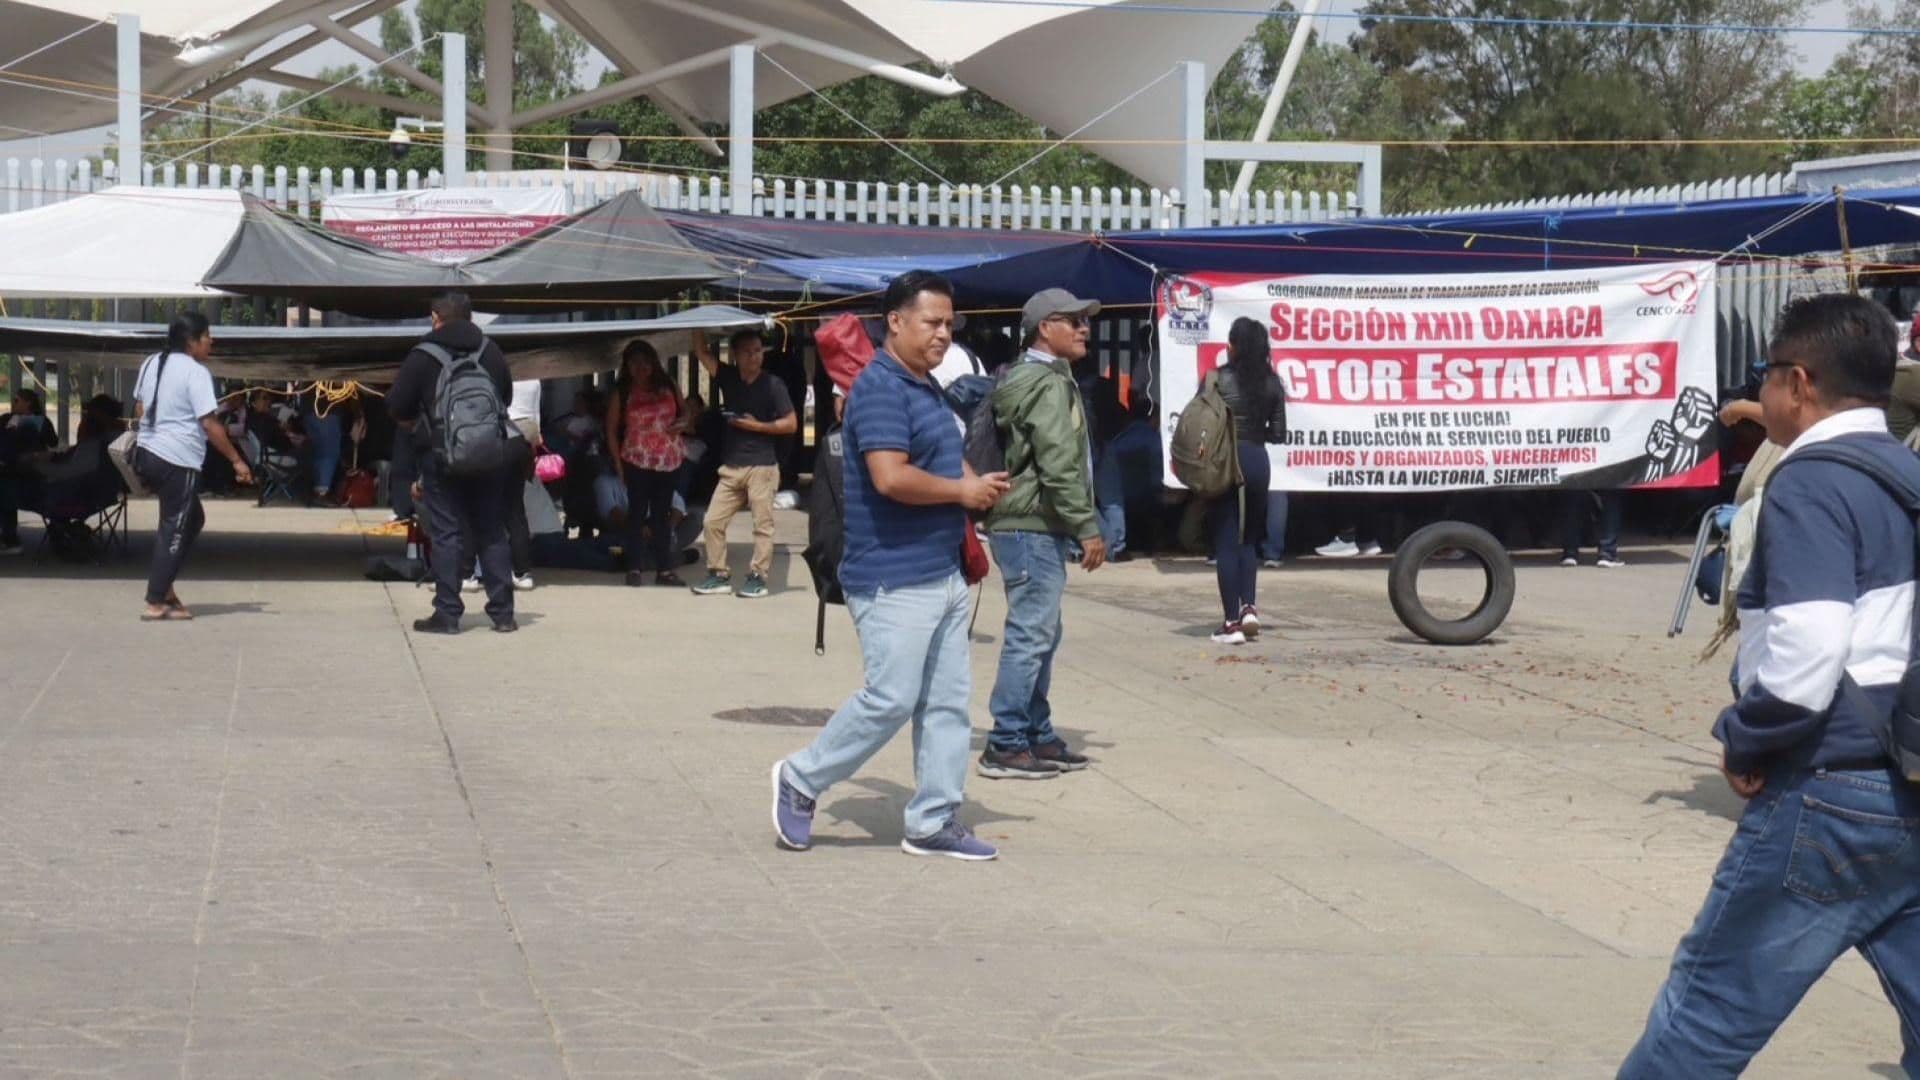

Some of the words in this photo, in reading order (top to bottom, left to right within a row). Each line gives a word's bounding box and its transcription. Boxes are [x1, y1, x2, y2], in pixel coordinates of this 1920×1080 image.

[410, 223, 420, 231] DE
[422, 222, 451, 230] ACCESO
[460, 221, 475, 229] LAS
[476, 220, 534, 229] INSTALACIONES
[1267, 283, 1353, 299] COORDINADORA
[1354, 285, 1408, 299] NACIONAL
[1410, 286, 1425, 298] DE
[1427, 284, 1507, 299] TRABAJADORES
[1508, 284, 1523, 297] DE
[1524, 283, 1538, 296] LA
[1538, 279, 1600, 296] EDUCACIÓN
[1270, 302, 1406, 342] SECCIÓN
[1412, 310, 1474, 341] XXII
[1479, 304, 1603, 341] OAXACA
[1215, 347, 1402, 401] CTOR
[1416, 352, 1662, 401] ESTATALES
[1374, 412, 1398, 429] ¡EN
[1402, 412, 1427, 428] PIE
[1430, 412, 1451, 427] DE
[1453, 411, 1511, 427] LUCHA!
[1285, 430, 1305, 446] OR
[1309, 430, 1328, 446] LA
[1331, 428, 1422, 446] EDUCACIÓN
[1426, 430, 1445, 446] AL
[1447, 429, 1522, 446] SERVICIO
[1525, 428, 1553, 445] DEL
[1556, 426, 1611, 444] PUEBLO
[1287, 450, 1355, 468] ¡UNIDOS
[1360, 450, 1369, 466] Y
[1373, 449, 1489, 467] ORGANIZADOS,
[1491, 447, 1598, 466] VENCEREMOS!
[1327, 469, 1385, 488] ¡HASTA
[1388, 470, 1408, 486] LA
[1493, 467, 1559, 485] SIEMPRE
